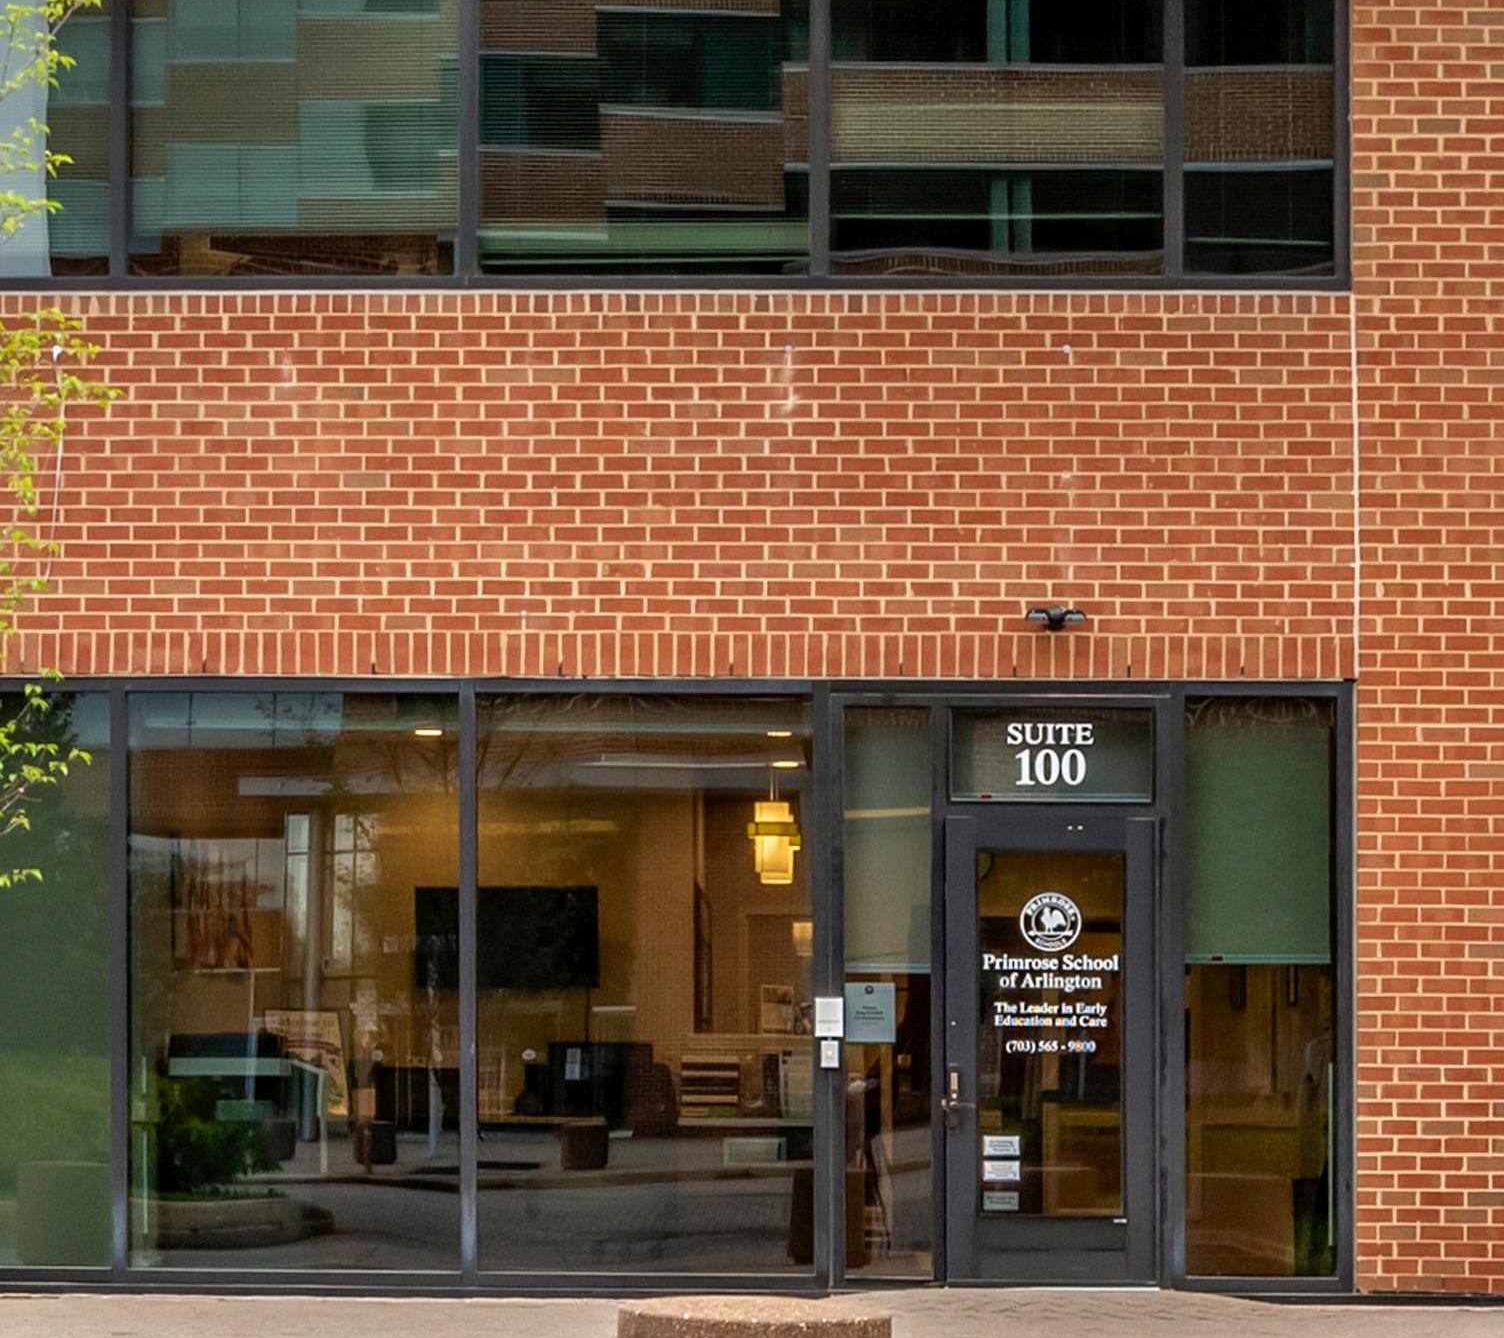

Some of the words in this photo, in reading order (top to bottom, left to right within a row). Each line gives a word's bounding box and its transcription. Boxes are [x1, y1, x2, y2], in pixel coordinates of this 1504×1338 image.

[1007, 722, 1094, 745] SUITE
[1015, 749, 1086, 786] 100
[982, 953, 1059, 970] Primrose
[1062, 954, 1119, 971] School
[999, 973, 1018, 988] of
[1021, 973, 1103, 992] Arlington
[994, 1002, 1017, 1013] The
[1019, 1002, 1059, 1014] Leader
[1076, 1002, 1107, 1016] Early
[994, 1015, 1053, 1026] Education
[1055, 1016, 1077, 1026] and
[1079, 1016, 1108, 1027] Care
[1006, 1040, 1036, 1053] (703)
[1038, 1040, 1059, 1052] 565
[1067, 1041, 1096, 1052] 9800
